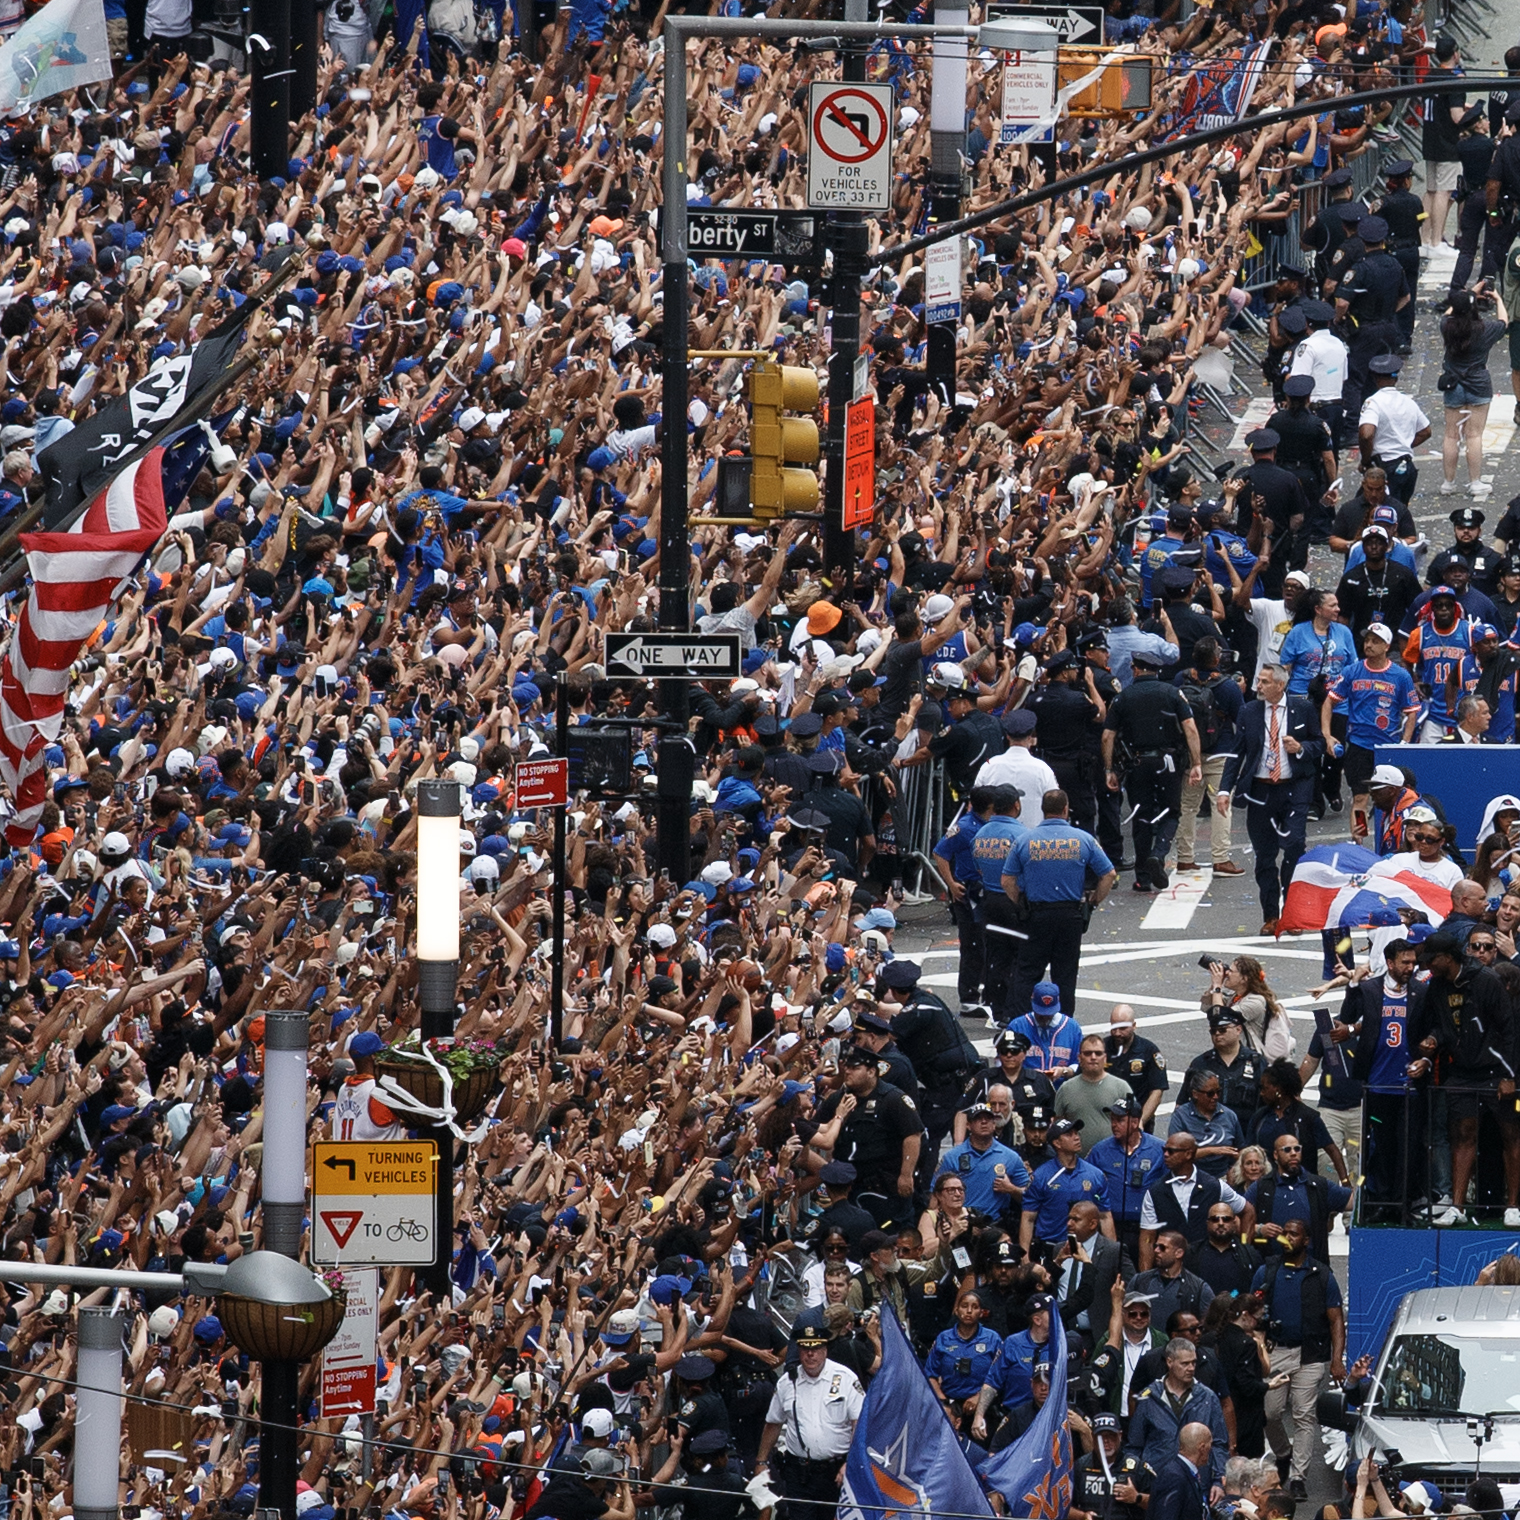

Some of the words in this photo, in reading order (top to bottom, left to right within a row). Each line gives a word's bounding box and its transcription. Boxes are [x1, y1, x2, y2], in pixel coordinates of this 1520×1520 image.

[1005, 72, 1043, 81] COMMERCIAL
[838, 166, 861, 177] FOR
[821, 179, 878, 191] VEHICLES
[815, 190, 846, 202] OVER
[850, 192, 864, 203] 33
[868, 192, 882, 203] FT
[753, 223, 767, 237] ST
[626, 647, 670, 666] ONE
[682, 647, 722, 665] WAY
[519, 766, 529, 776] NO
[529, 763, 560, 776] STOPPING
[519, 776, 545, 788] Anytime
[1029, 839, 1080, 851] NYPD
[1385, 1022, 1403, 1048] 3
[368, 1151, 423, 1165] TURNING
[363, 1170, 427, 1184] VEHICLES
[363, 1223, 382, 1238] TO
[357, 1306, 373, 1317] ONLY
[325, 1373, 335, 1382] NO
[336, 1369, 367, 1382] STOPPING
[325, 1383, 352, 1395] Anytime
